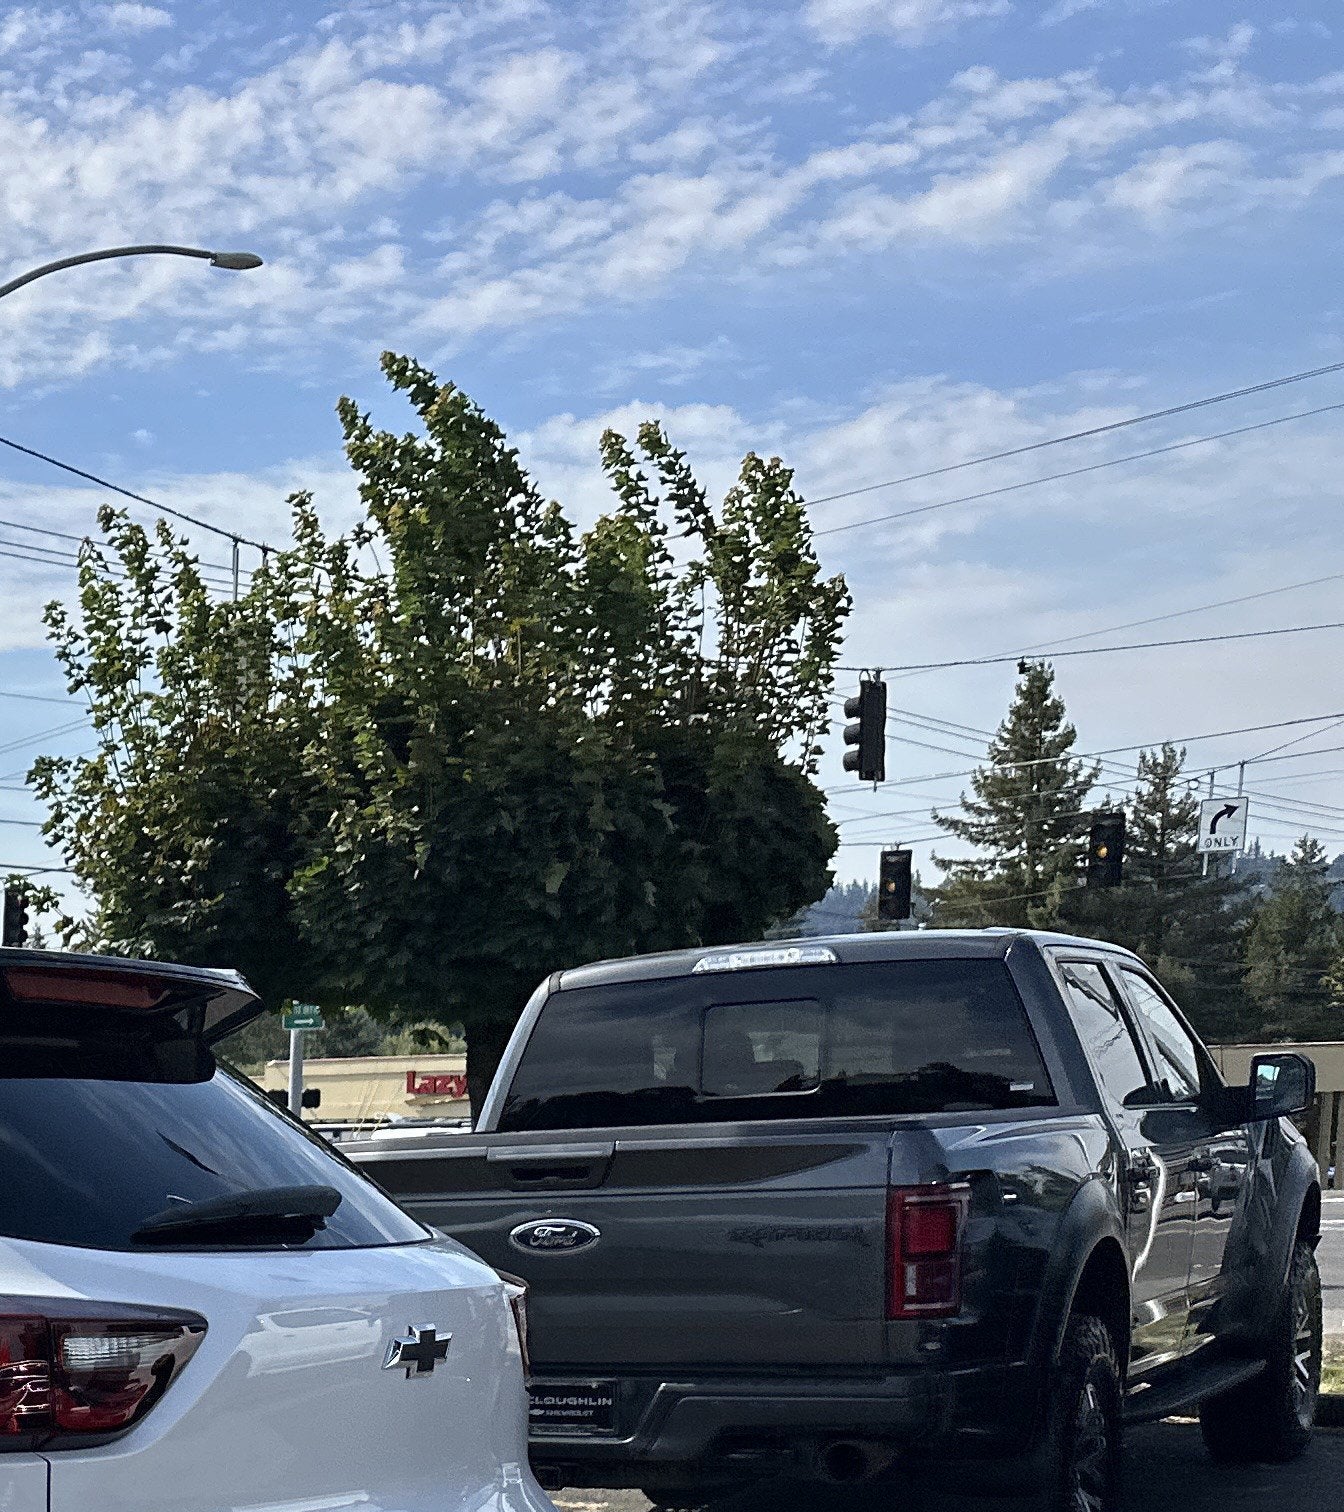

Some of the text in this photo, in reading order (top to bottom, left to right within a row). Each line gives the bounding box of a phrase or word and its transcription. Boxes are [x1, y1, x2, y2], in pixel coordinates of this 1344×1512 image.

[1204, 835, 1239, 848] ONLY
[406, 1070, 468, 1099] Lazy
[529, 1226, 578, 1247] Ford
